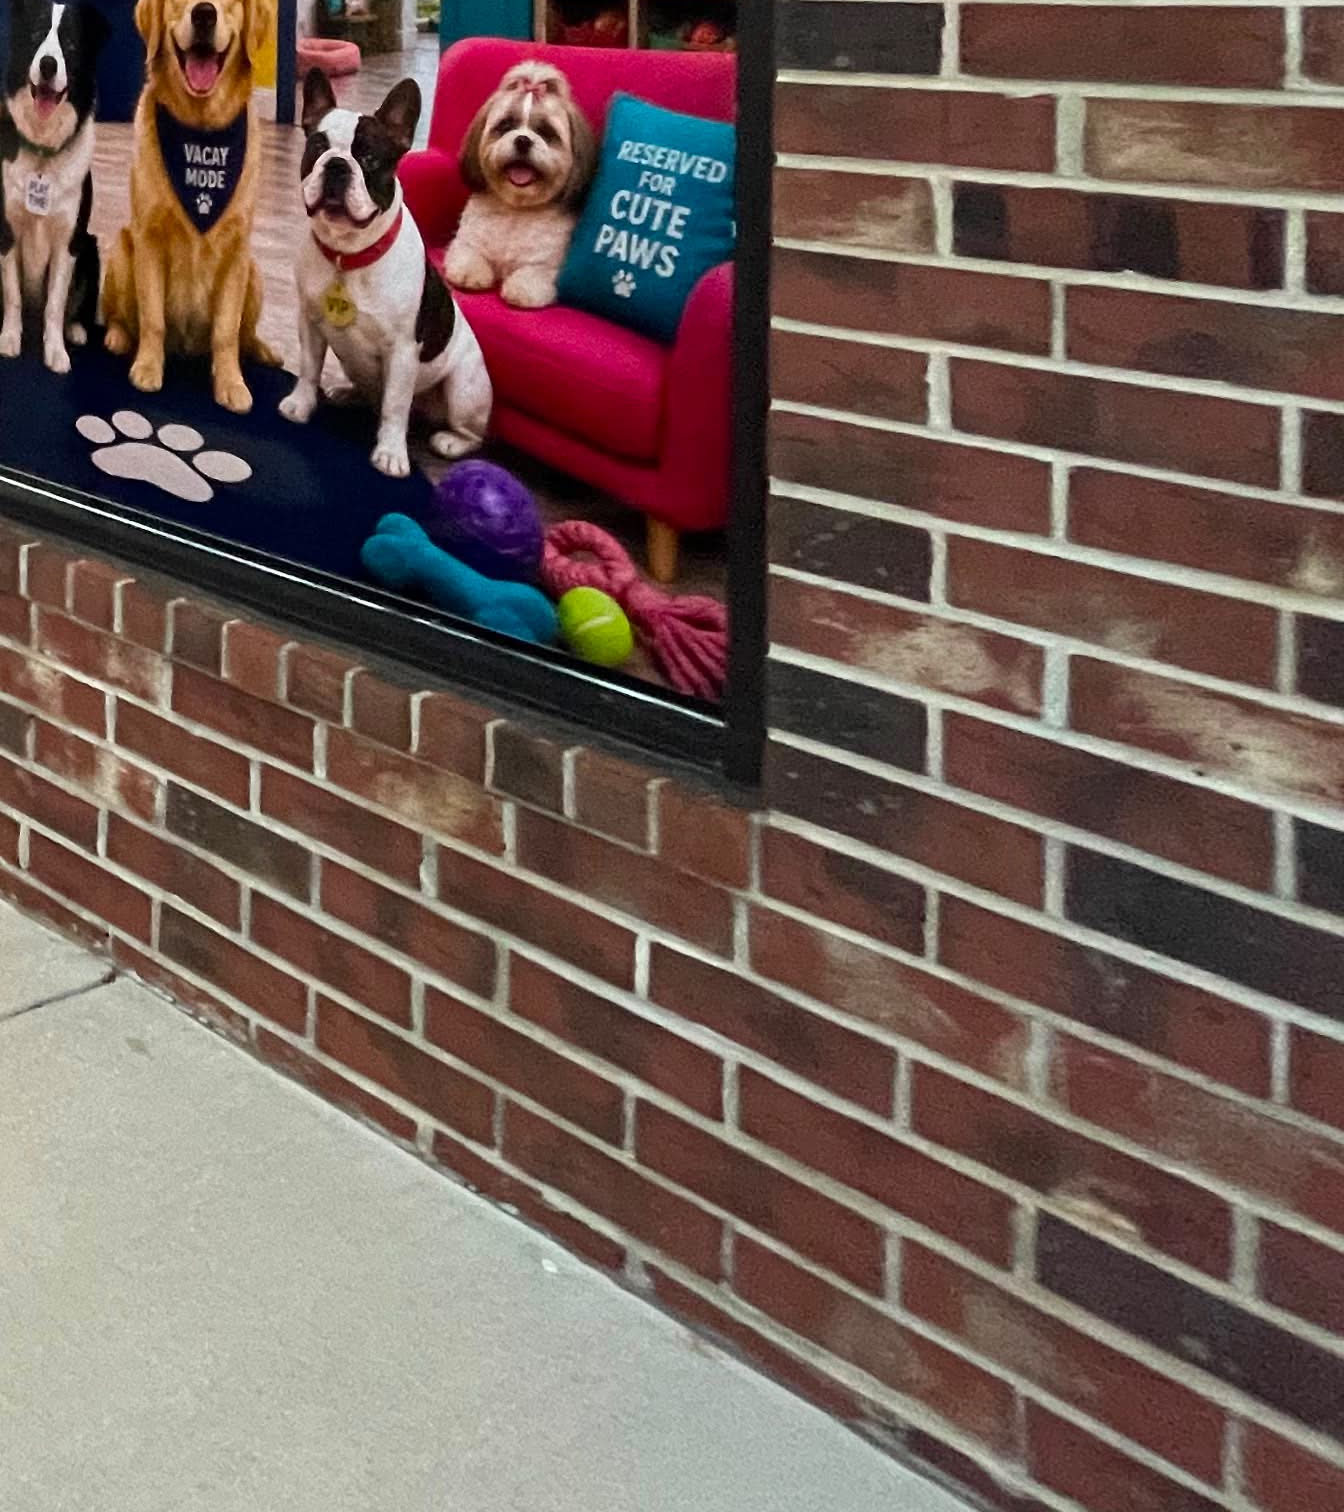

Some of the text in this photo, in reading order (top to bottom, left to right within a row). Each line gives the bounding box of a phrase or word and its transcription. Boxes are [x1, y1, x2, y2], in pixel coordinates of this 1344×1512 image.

[184, 143, 230, 166] VACAY
[617, 140, 728, 183] RESERVED
[185, 168, 226, 189] MODE
[638, 170, 677, 196] FOR
[611, 189, 691, 240] CUTE
[594, 224, 681, 278] PAWS
